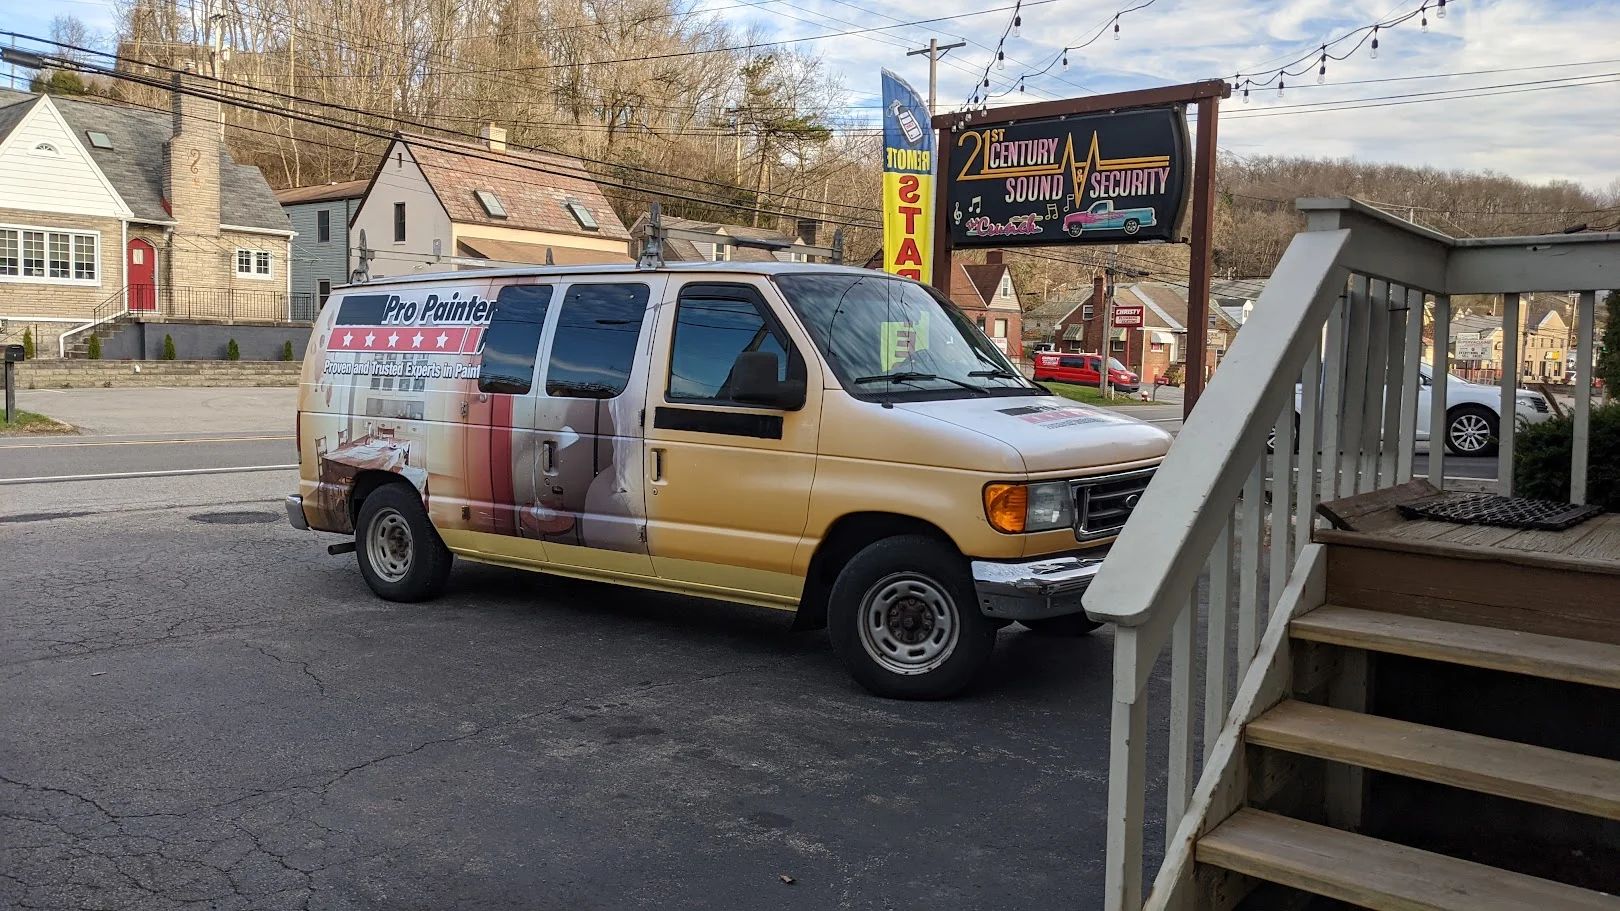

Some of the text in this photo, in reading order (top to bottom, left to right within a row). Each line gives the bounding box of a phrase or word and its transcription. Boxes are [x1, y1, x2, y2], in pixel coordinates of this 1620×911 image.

[990, 138, 1059, 168] CENTURY
[1005, 167, 1170, 203] SOUND & SECURITY
[381, 294, 418, 325] Pro
[324, 359, 352, 374] Proven
[353, 361, 370, 375] and
[371, 360, 404, 377] Trusted
[405, 361, 441, 380] Experts
[443, 362, 454, 378] in
